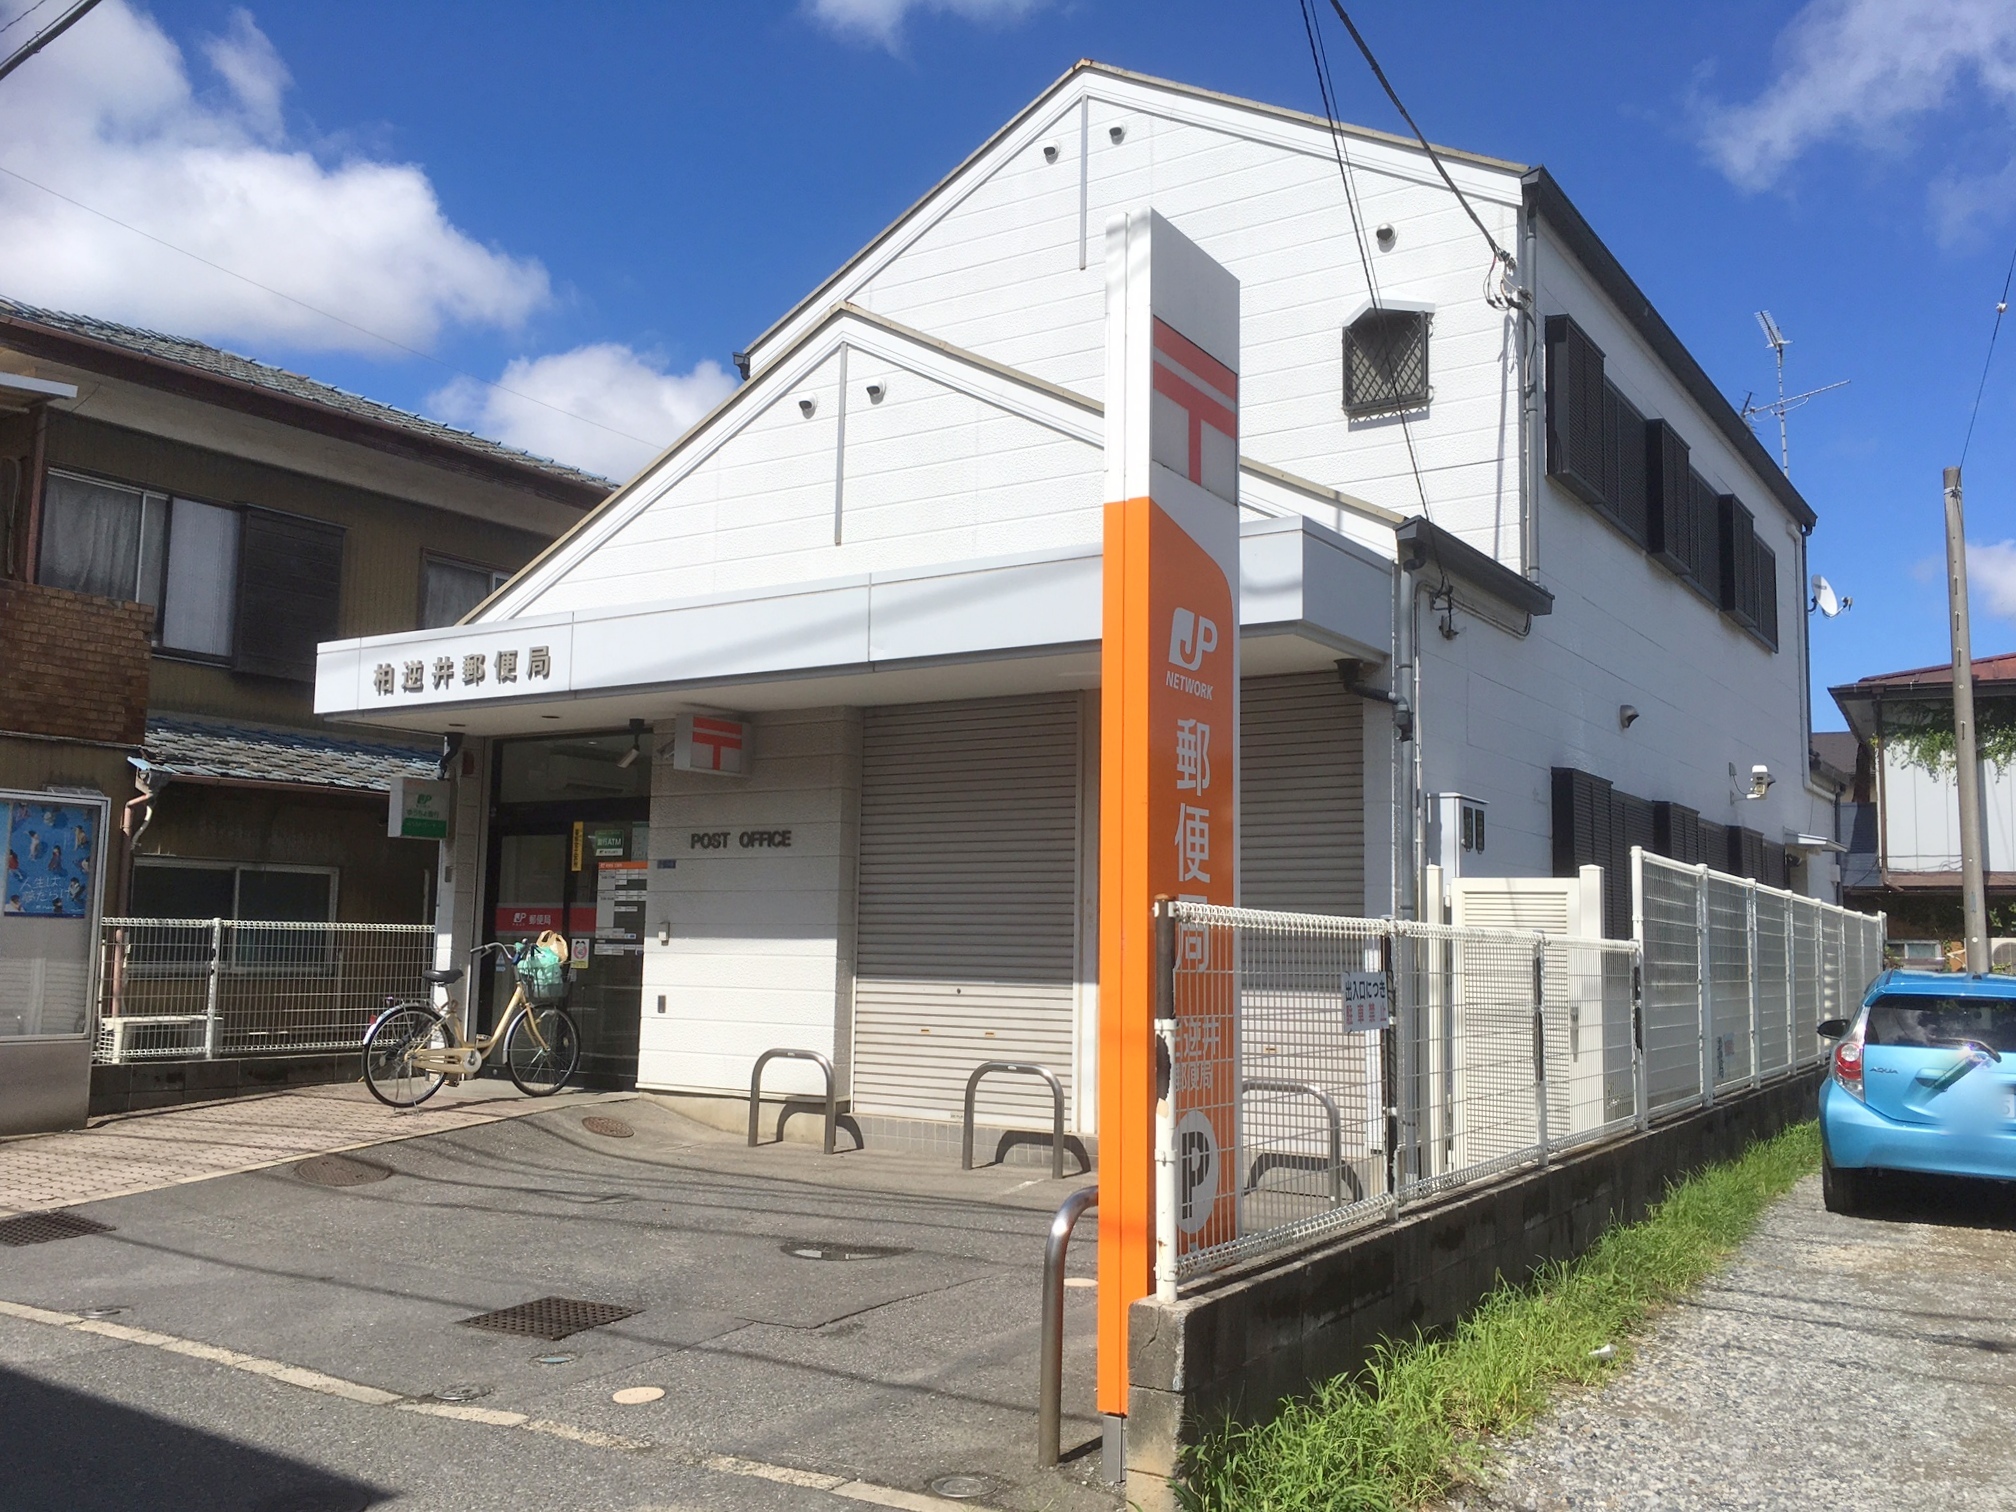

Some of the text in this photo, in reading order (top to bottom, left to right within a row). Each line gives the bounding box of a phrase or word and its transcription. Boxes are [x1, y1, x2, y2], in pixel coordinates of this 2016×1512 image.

[373, 645, 551, 695] 柏逆井郵便局
[1165, 671, 1213, 701] NETWORK
[690, 830, 792, 849] POST OFFICE
[529, 914, 551, 925] 郵便局
[1345, 980, 1386, 1001] 出入口につき
[1346, 1001, 1387, 1025] 駐車禁止
[1869, 1066, 1899, 1075] AQUA
